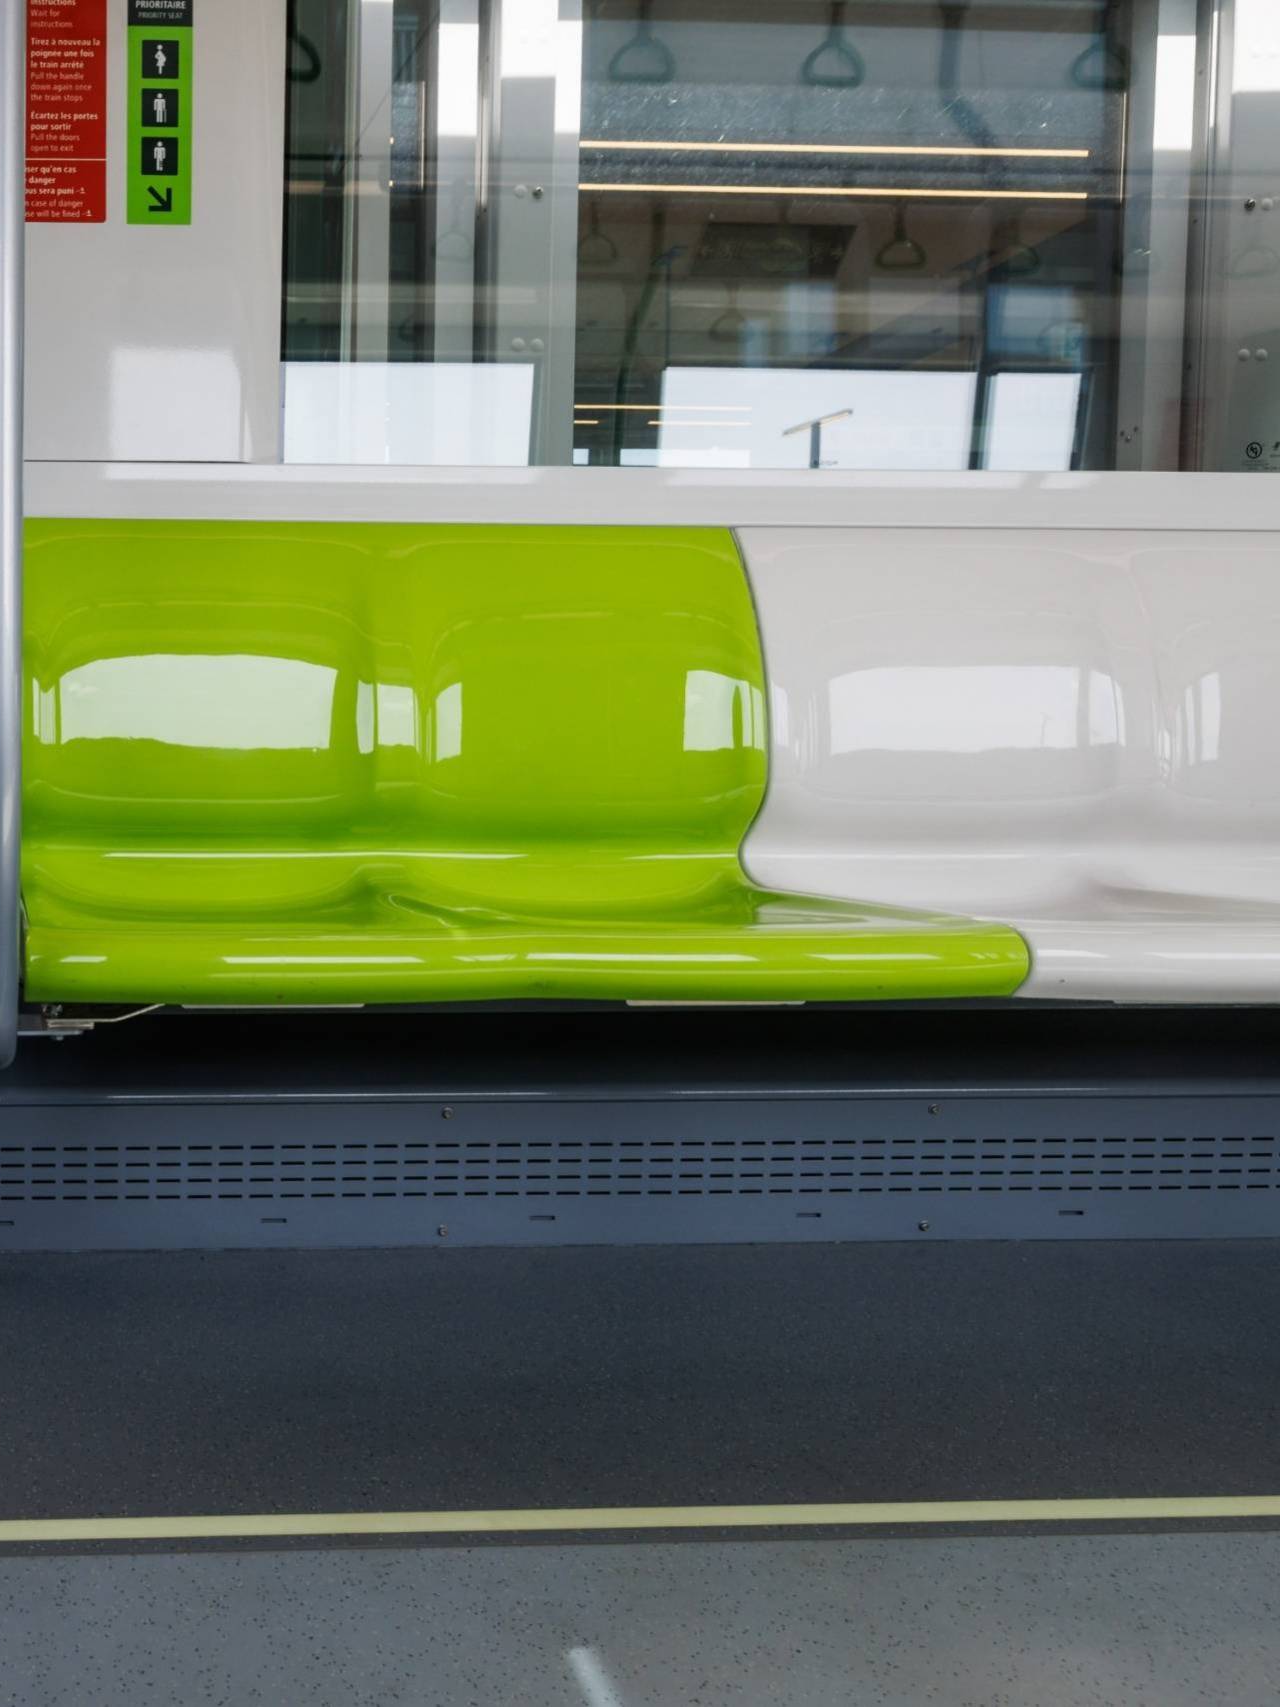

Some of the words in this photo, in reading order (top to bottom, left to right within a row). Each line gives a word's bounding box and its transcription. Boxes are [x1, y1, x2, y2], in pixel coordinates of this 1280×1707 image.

[135, 0, 186, 9] PRIORITAIRE
[30, 9, 48, 17] Wait
[49, 8, 60, 17] for
[138, 11, 167, 19] PRIORITY
[31, 38, 50, 46] Tirez
[93, 38, 101, 46] la
[80, 49, 95, 57] fois
[31, 60, 38, 69] le
[40, 61, 58, 69] train
[31, 72, 45, 80] Pull
[46, 72, 58, 80] the
[60, 72, 84, 80] handle
[31, 83, 51, 91] down
[52, 84, 73, 93] again
[31, 94, 42, 102] the
[44, 94, 61, 102] train
[63, 95, 83, 103] stops
[31, 111, 59, 120] Écartez
[60, 112, 72, 120] les
[73, 112, 98, 121] portes
[31, 124, 48, 132] pour
[50, 123, 72, 131] sortir
[31, 133, 44, 141] Pull
[46, 133, 57, 141] the
[31, 145, 49, 153] open
[50, 144, 58, 152] to
[60, 145, 74, 153] exit
[28, 176, 56, 186] danger
[57, 187, 74, 197] puni
[30, 200, 47, 208] case
[48, 199, 57, 208] of
[58, 200, 84, 209] danger
[36, 210, 50, 218] will
[51, 210, 61, 218] be
